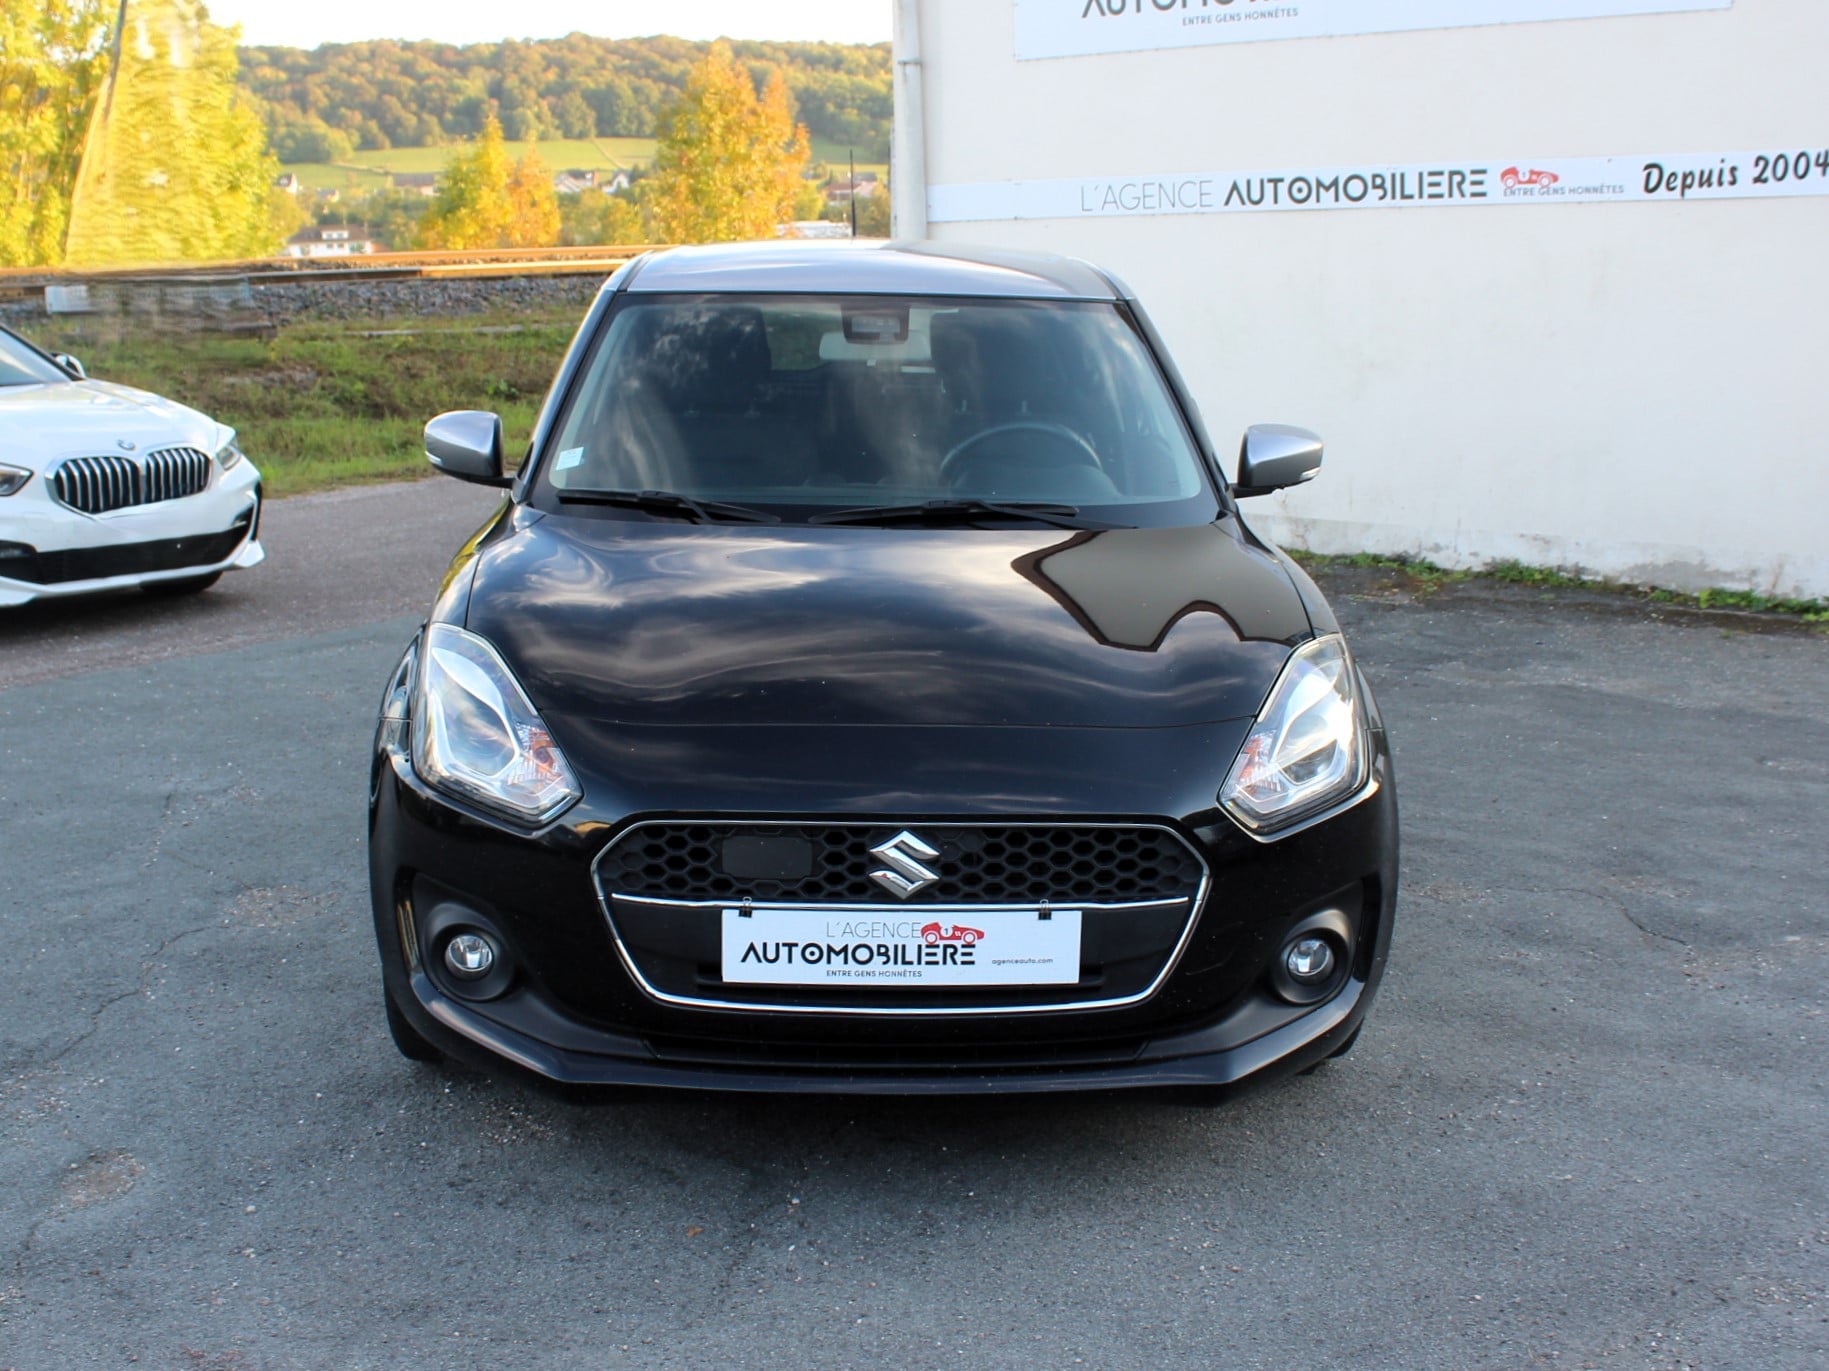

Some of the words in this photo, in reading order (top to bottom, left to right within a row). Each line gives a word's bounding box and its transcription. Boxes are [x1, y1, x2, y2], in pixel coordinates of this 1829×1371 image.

[1182, 15, 1212, 26] ENTRE
[1215, 12, 1242, 24] GENS
[1244, 8, 1299, 20] HONNÊTES
[1642, 158, 1738, 199] Depuis
[1752, 149, 1829, 185] 2004
[1224, 169, 1488, 207] AUTOMOBILIERE
[1503, 187, 1535, 197] ENTRE
[1538, 186, 1566, 196] GENS
[1568, 184, 1625, 195] HONNÊTES
[741, 942, 976, 966] AUTOMOBILIERE
[854, 970, 876, 978] GENS
[878, 968, 922, 978] HONNÊTES
